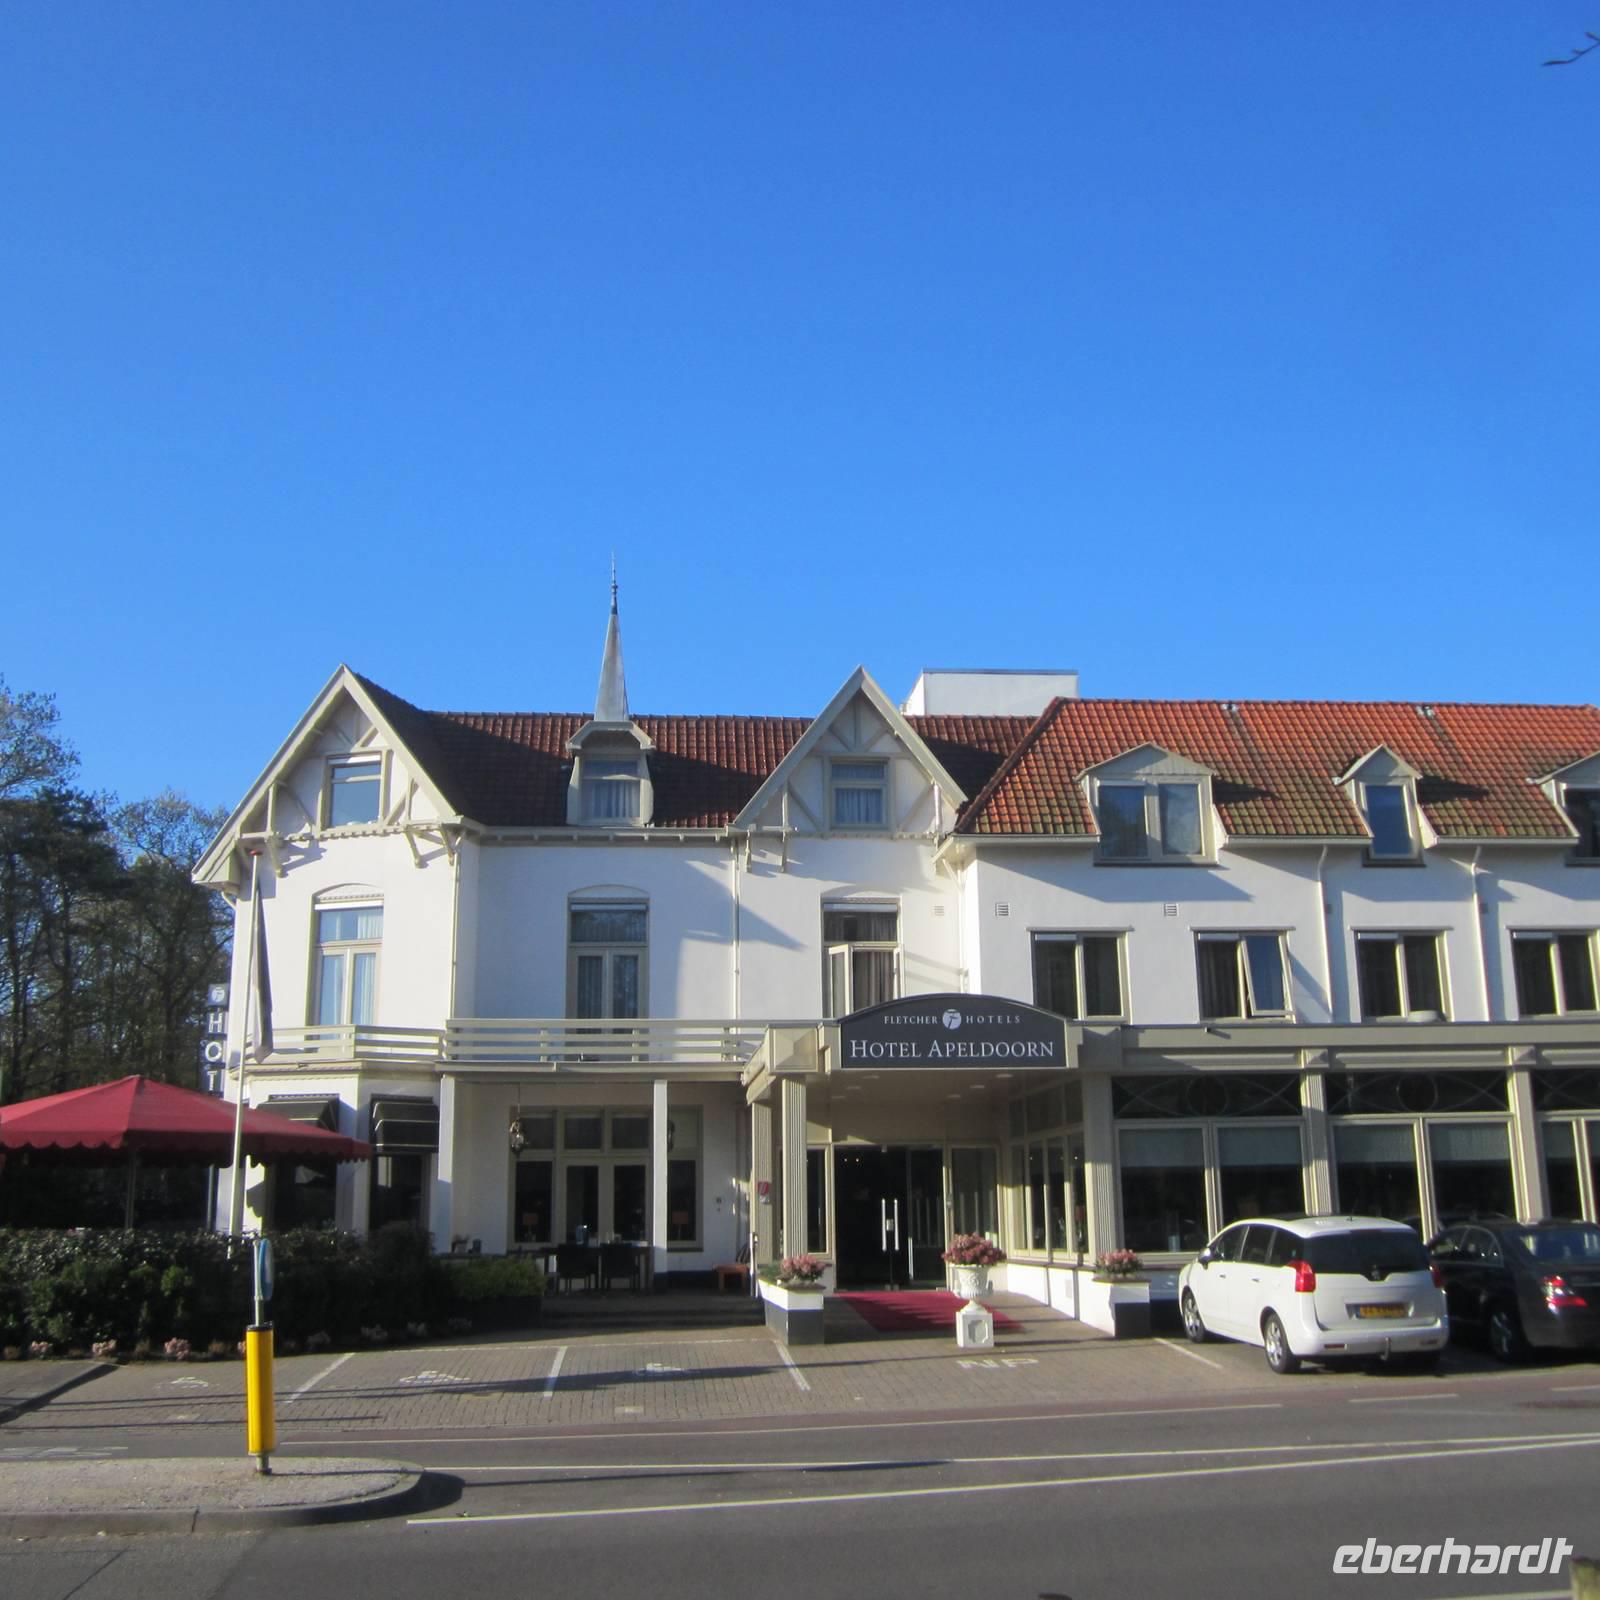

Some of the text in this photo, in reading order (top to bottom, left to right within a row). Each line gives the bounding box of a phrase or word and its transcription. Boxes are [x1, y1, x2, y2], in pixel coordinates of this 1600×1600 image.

[884, 1014, 938, 1025] FLETCHER
[966, 1014, 1021, 1025] HOTELS
[850, 1039, 1054, 1058] HOTEL APELDOORN
